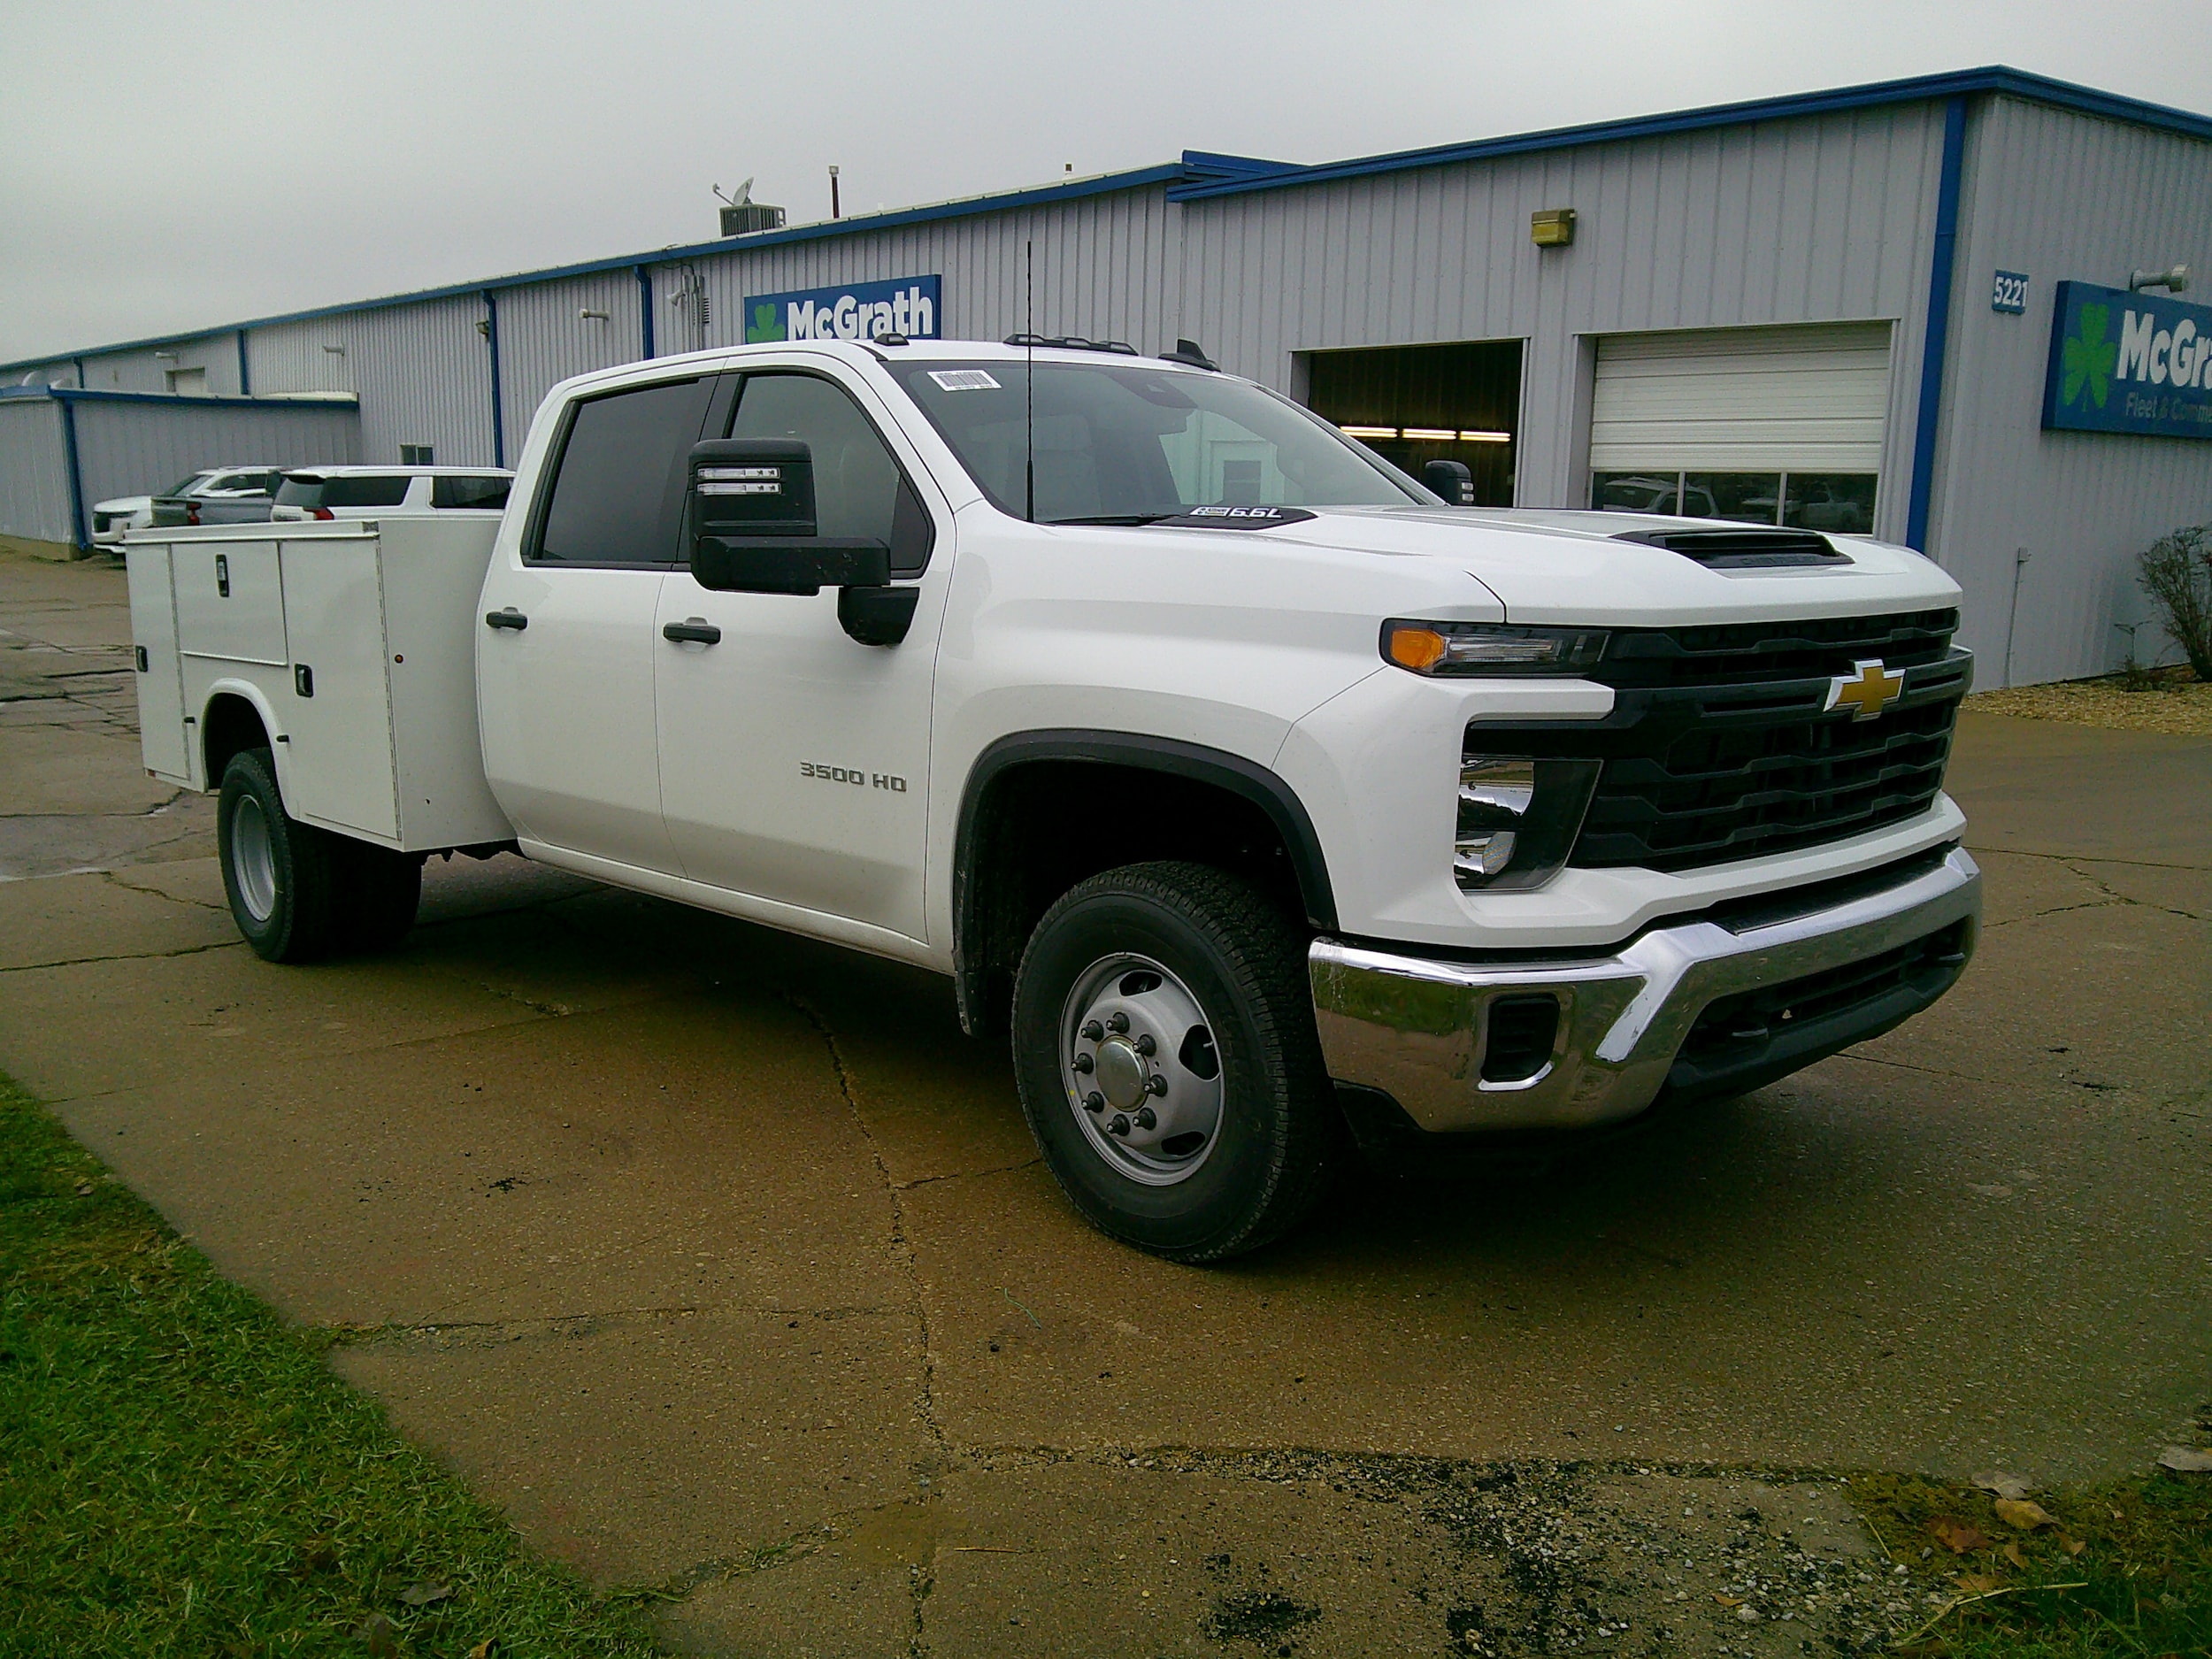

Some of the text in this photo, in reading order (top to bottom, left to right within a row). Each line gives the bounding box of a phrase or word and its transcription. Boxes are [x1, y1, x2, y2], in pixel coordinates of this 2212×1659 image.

[1993, 276, 2028, 308] 5221
[787, 286, 933, 341] McGrath
[2125, 391, 2158, 419] Fleet
[800, 761, 907, 793] 3500 HD
